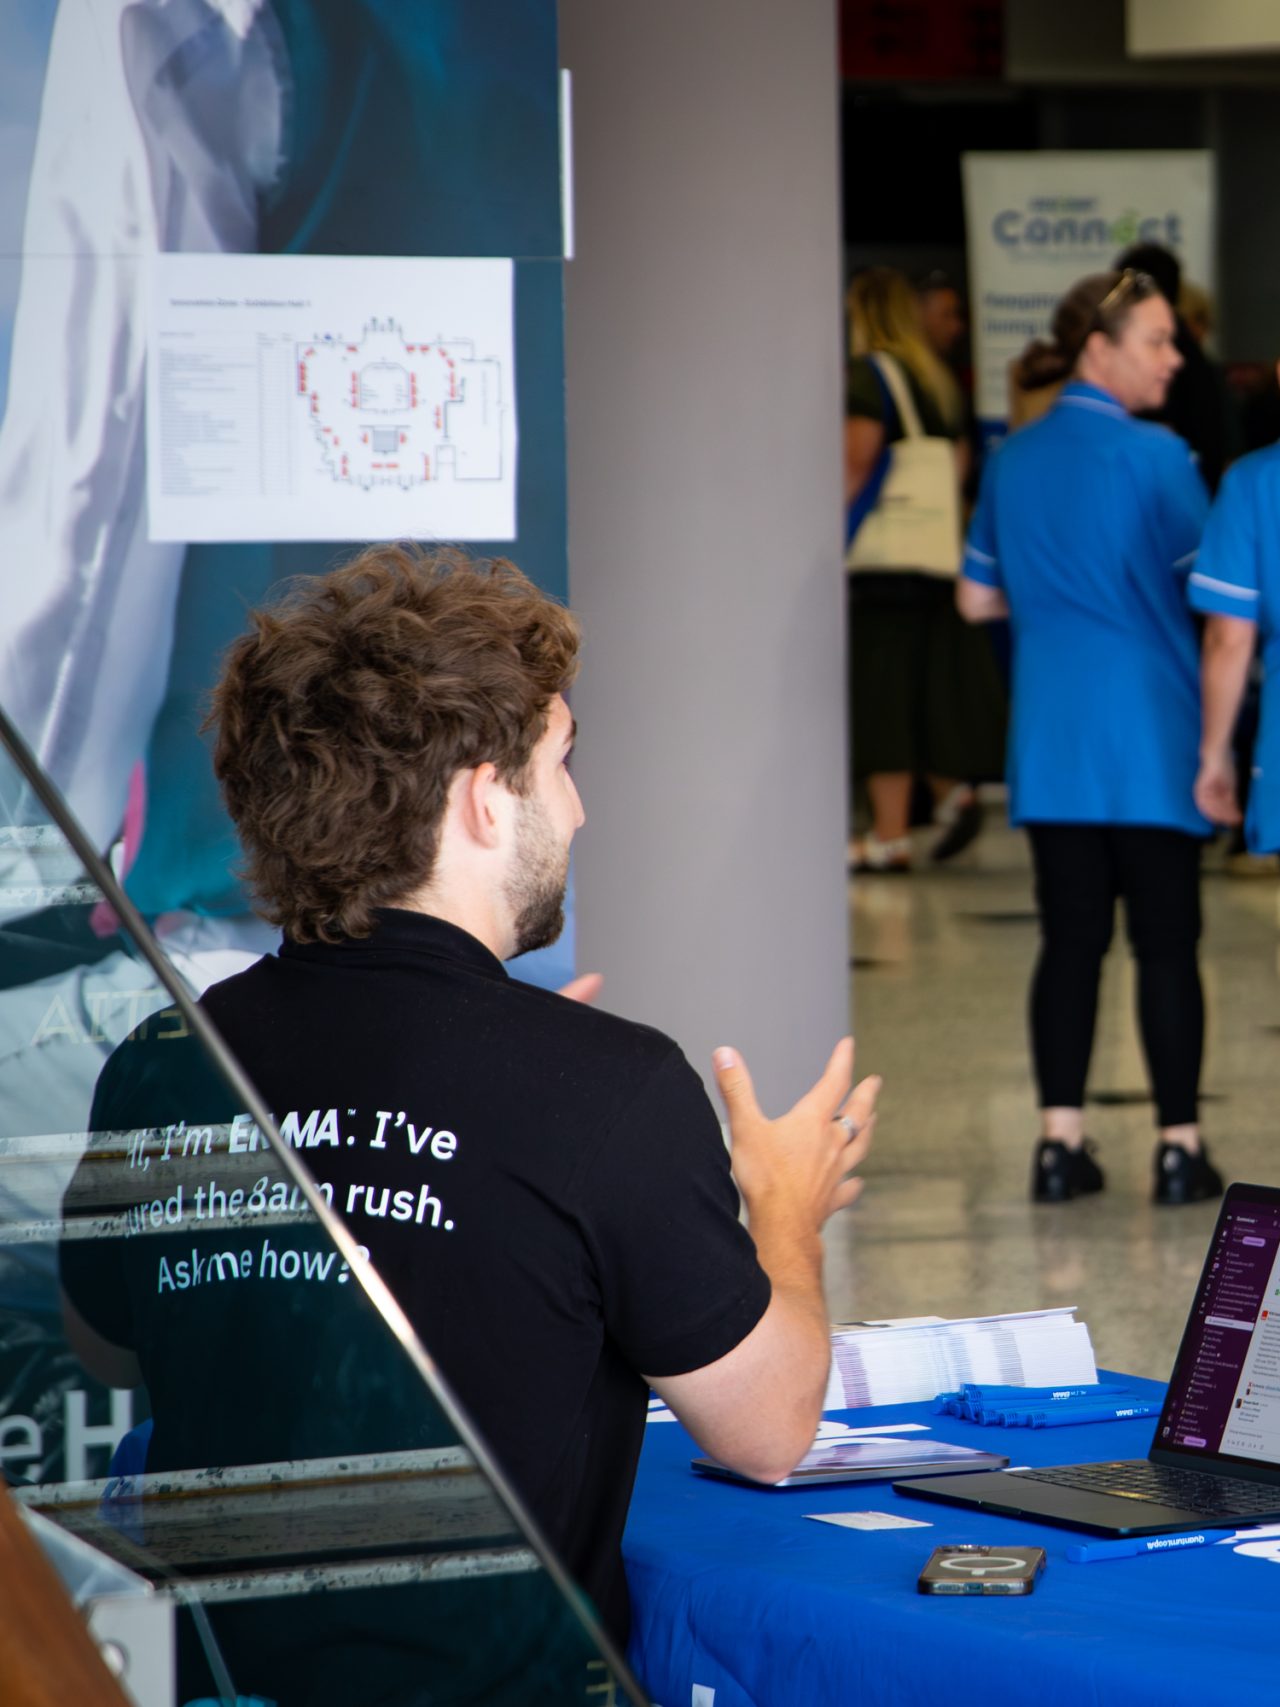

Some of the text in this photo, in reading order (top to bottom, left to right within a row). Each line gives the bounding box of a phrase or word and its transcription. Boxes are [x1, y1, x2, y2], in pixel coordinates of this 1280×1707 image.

[161, 1120, 212, 1161] I'm
[370, 1110, 457, 1161] I've
[125, 1185, 182, 1239] ured
[194, 1181, 244, 1220] the
[346, 1184, 455, 1231] rush.
[158, 1249, 205, 1293] Ask
[206, 1250, 252, 1279] me
[1147, 1535, 1204, 1549] QuantumLoopAI
